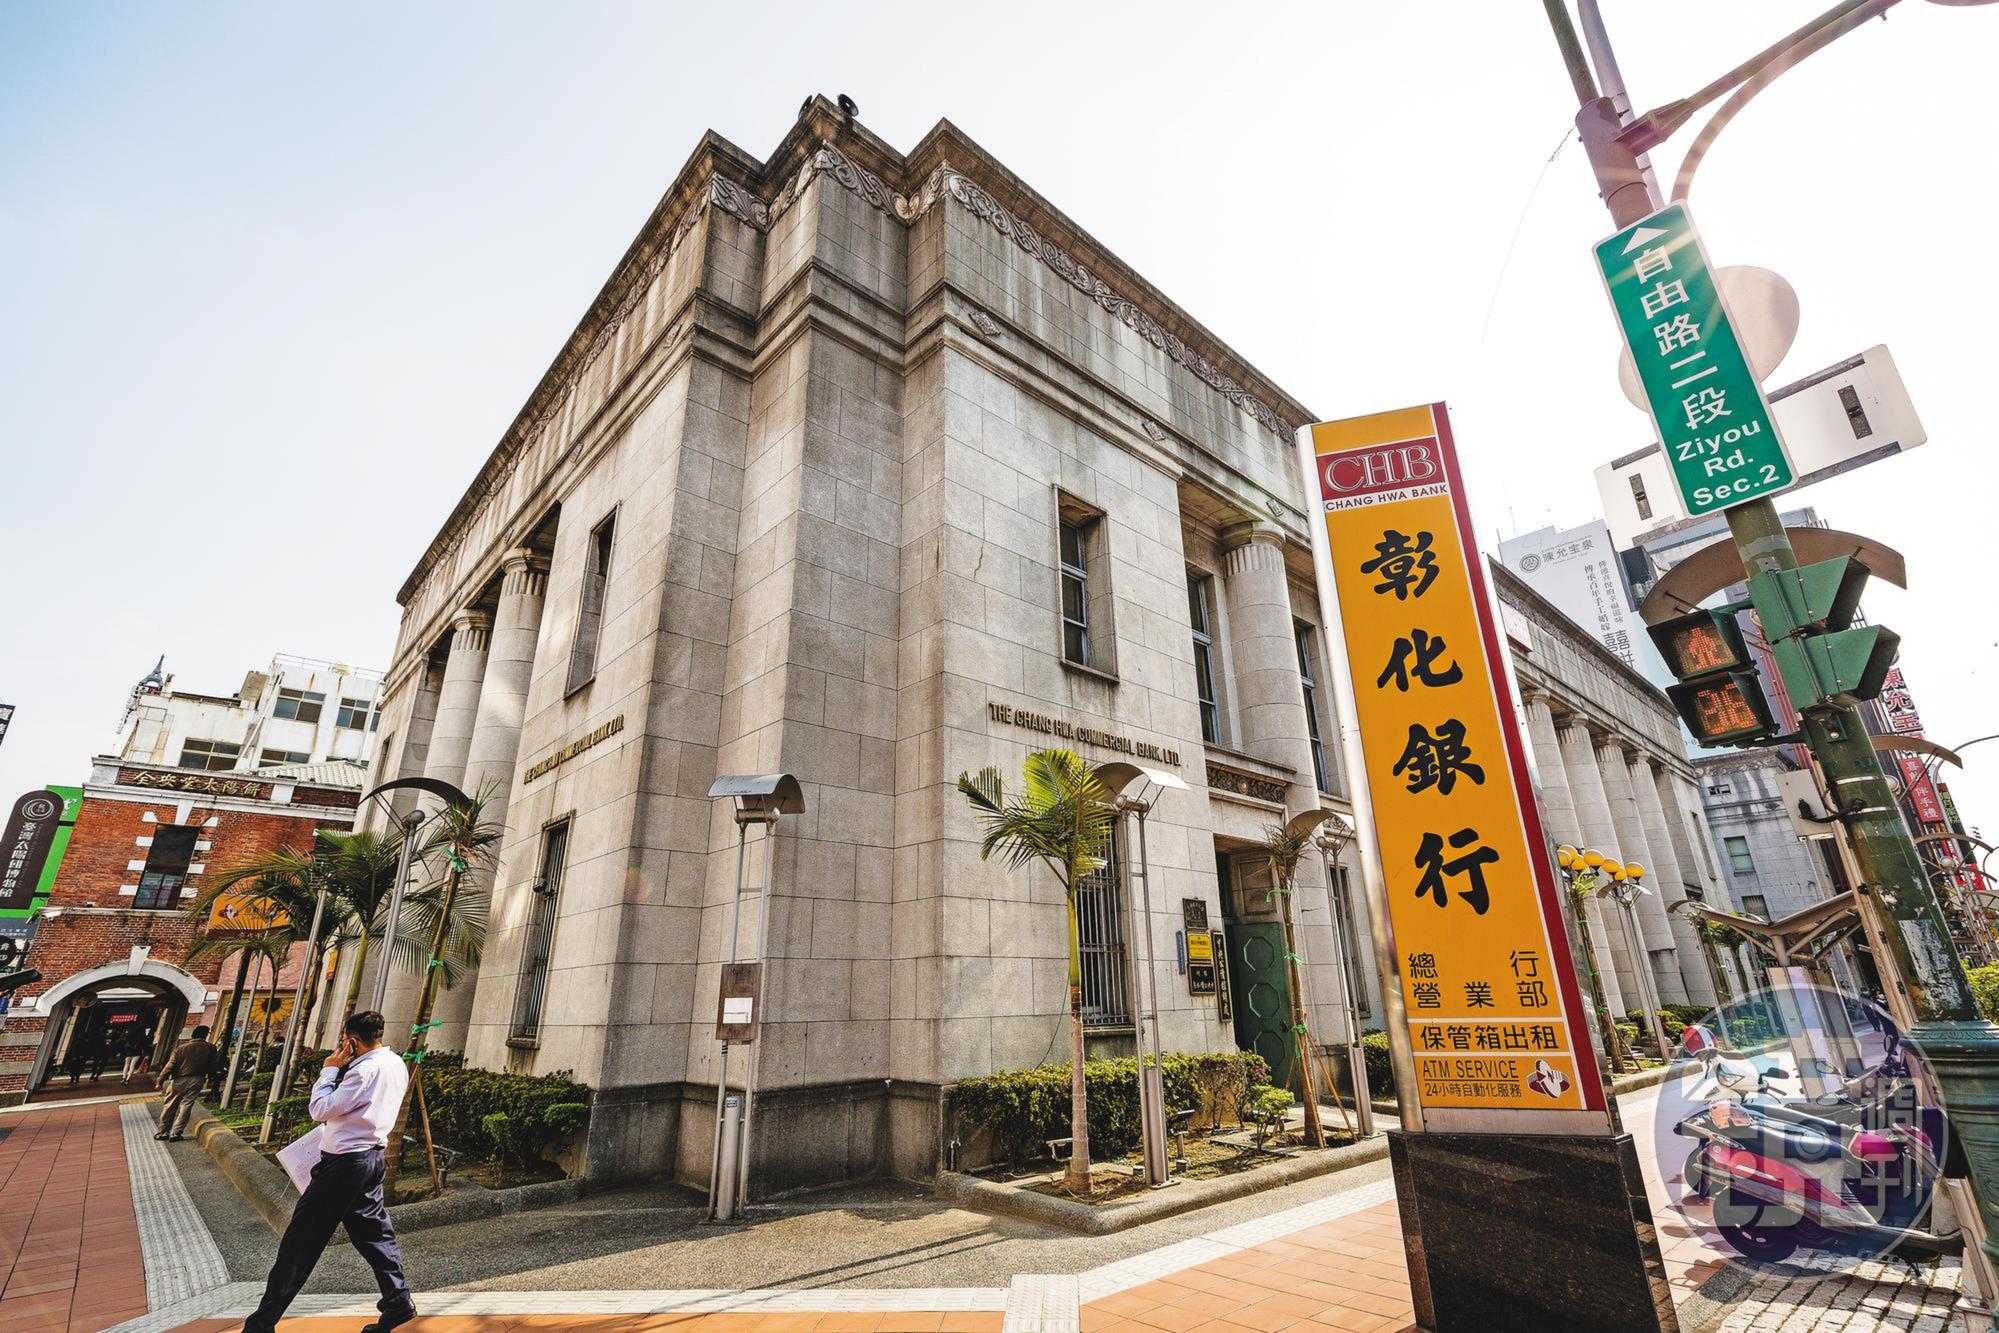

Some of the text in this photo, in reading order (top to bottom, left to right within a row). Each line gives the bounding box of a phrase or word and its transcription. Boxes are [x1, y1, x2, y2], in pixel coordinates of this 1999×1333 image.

[1633, 244, 1732, 430] 自由路二段
[1675, 419, 1761, 462] Ziyou
[1325, 445, 1437, 492] CHB
[1703, 449, 1754, 477] Rd.
[1325, 484, 1447, 511] CHANG HWA BANK
[1693, 464, 1779, 507] Sec.2
[989, 703, 1012, 724] THE
[1014, 709, 1052, 734] CHANG
[1054, 719, 1074, 740] HWA
[1077, 727, 1135, 755] COMMERCIAL
[1360, 529, 1500, 916] 彰化銀行
[1420, 1025, 1559, 1050] 保管箱出租
[1423, 1060, 1519, 1079] ATM SERVICE
[1424, 1083, 1522, 1098] 24小時自動化服務
